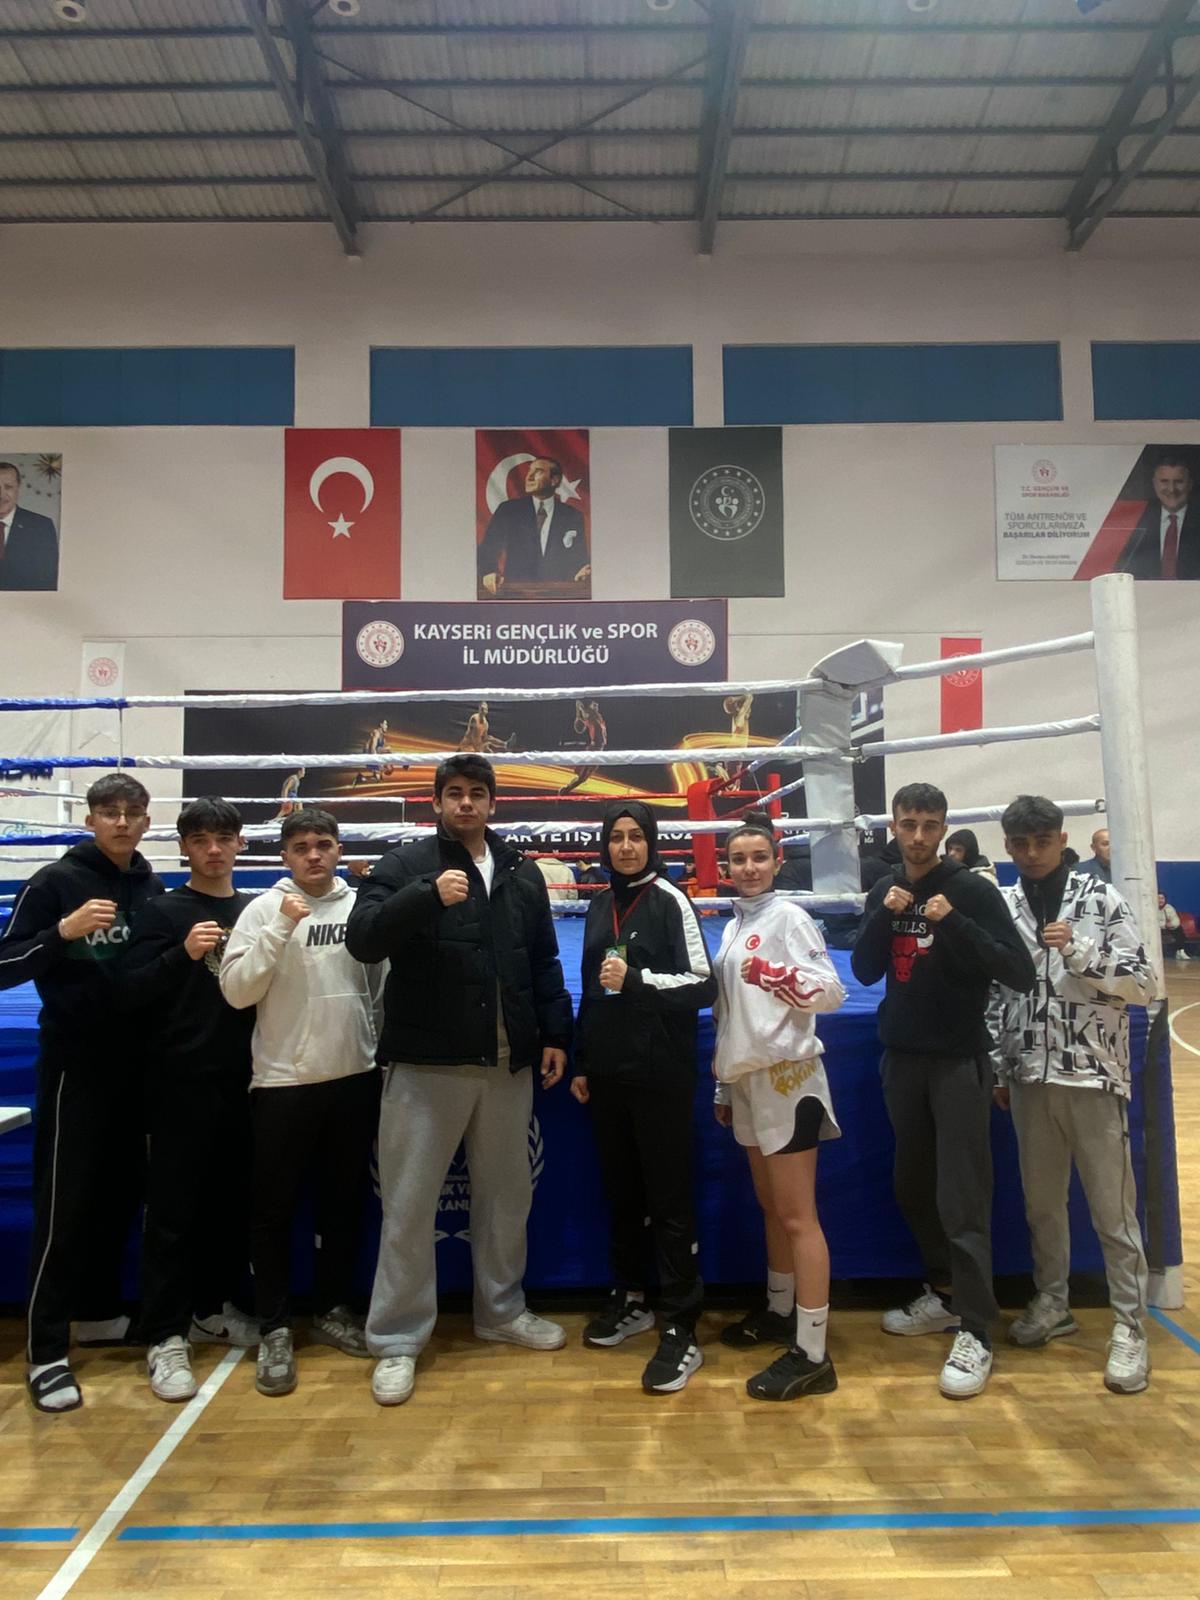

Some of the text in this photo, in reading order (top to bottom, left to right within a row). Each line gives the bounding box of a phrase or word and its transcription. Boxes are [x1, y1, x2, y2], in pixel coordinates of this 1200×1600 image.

[1004, 511, 1088, 521] TÜM ANTRENÖR VE
[581, 626, 604, 639] ve
[607, 622, 658, 639] SPOR
[463, 644, 609, 665] İL MÜDÜRLÜĞÜ
